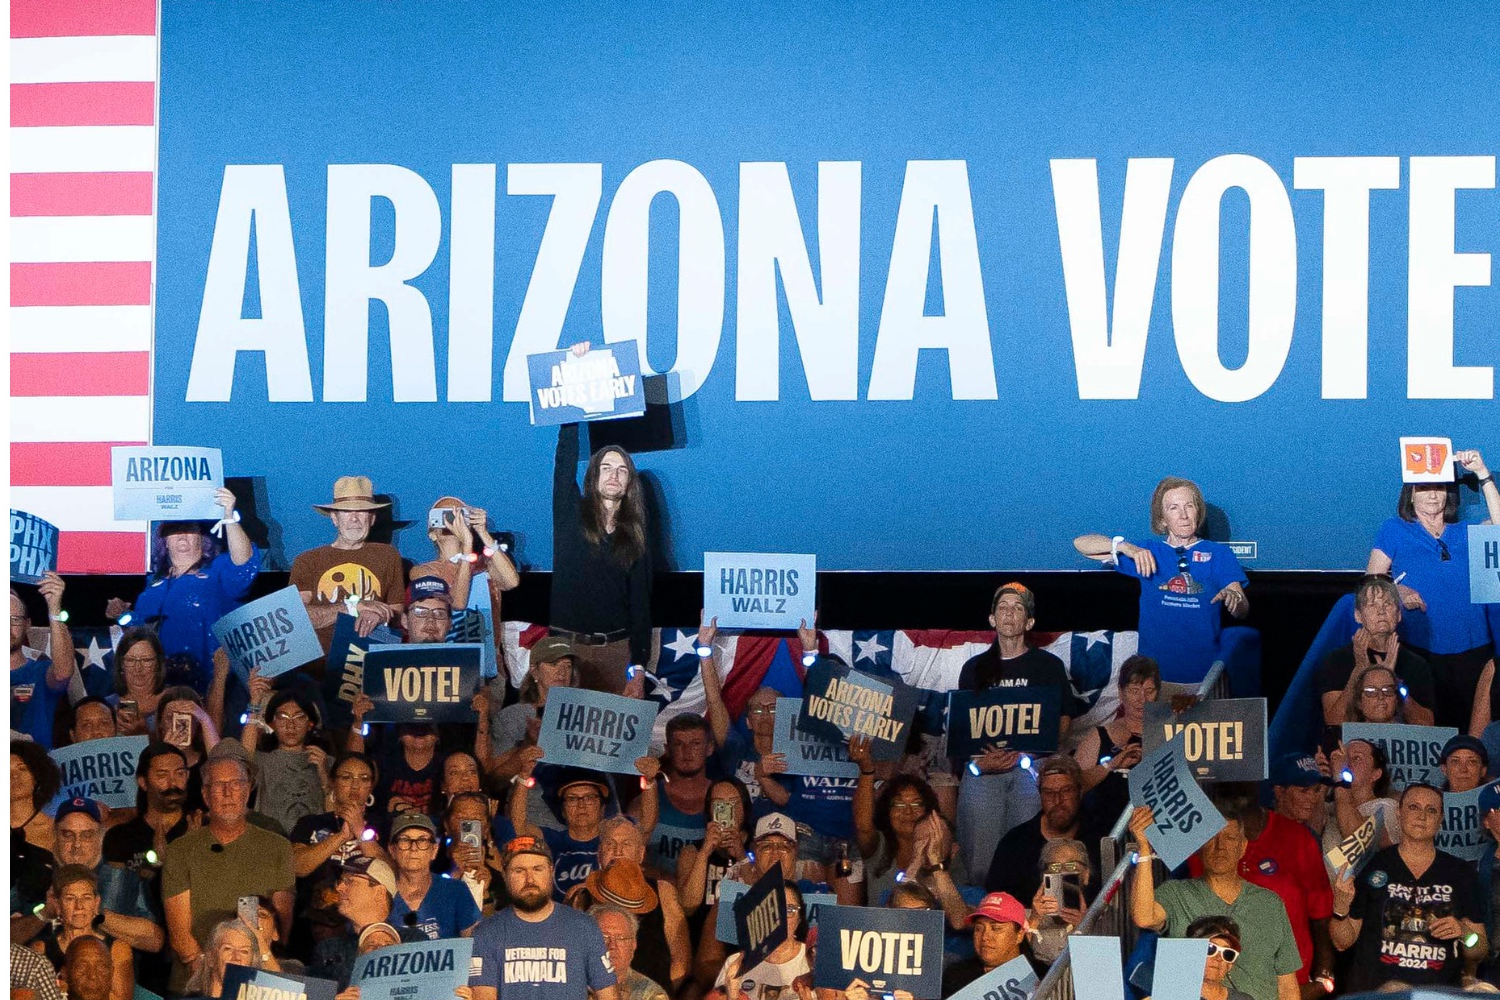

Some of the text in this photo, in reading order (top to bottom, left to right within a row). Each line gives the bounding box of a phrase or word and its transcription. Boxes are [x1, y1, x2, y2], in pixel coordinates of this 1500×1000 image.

[184, 154, 1498, 403] ARIZONA VOTE
[126, 457, 212, 482] ARIZONA
[156, 494, 182, 504] HARRIS
[415, 581, 444, 590] HARRIS
[720, 568, 799, 596] HARRIS
[731, 598, 787, 614] WALZ
[224, 606, 295, 654] HARRIS
[240, 637, 292, 671] WALZ
[383, 666, 460, 702] VOTE!
[825, 678, 895, 718] ARIZONA
[556, 701, 639, 741] HARRIS
[807, 695, 854, 731] VOTES
[853, 713, 904, 744] EARLY
[969, 703, 1041, 739] VOTE!
[565, 734, 621, 758] WALZ
[67, 778, 126, 800] WALZ
[1151, 751, 1203, 835] HARRIS
[1141, 778, 1175, 836] WALZ
[1433, 885, 1452, 894] TO
[746, 888, 780, 951] VOTE!
[361, 949, 456, 981] ARIZONA
[504, 947, 567, 961] VETERANS FOR
[839, 928, 924, 975] VOTE!
[1381, 940, 1447, 961] HARRIS
[1398, 959, 1428, 969] 2024
[504, 958, 567, 984] KAMALA
[389, 986, 419, 996] HARRIS
